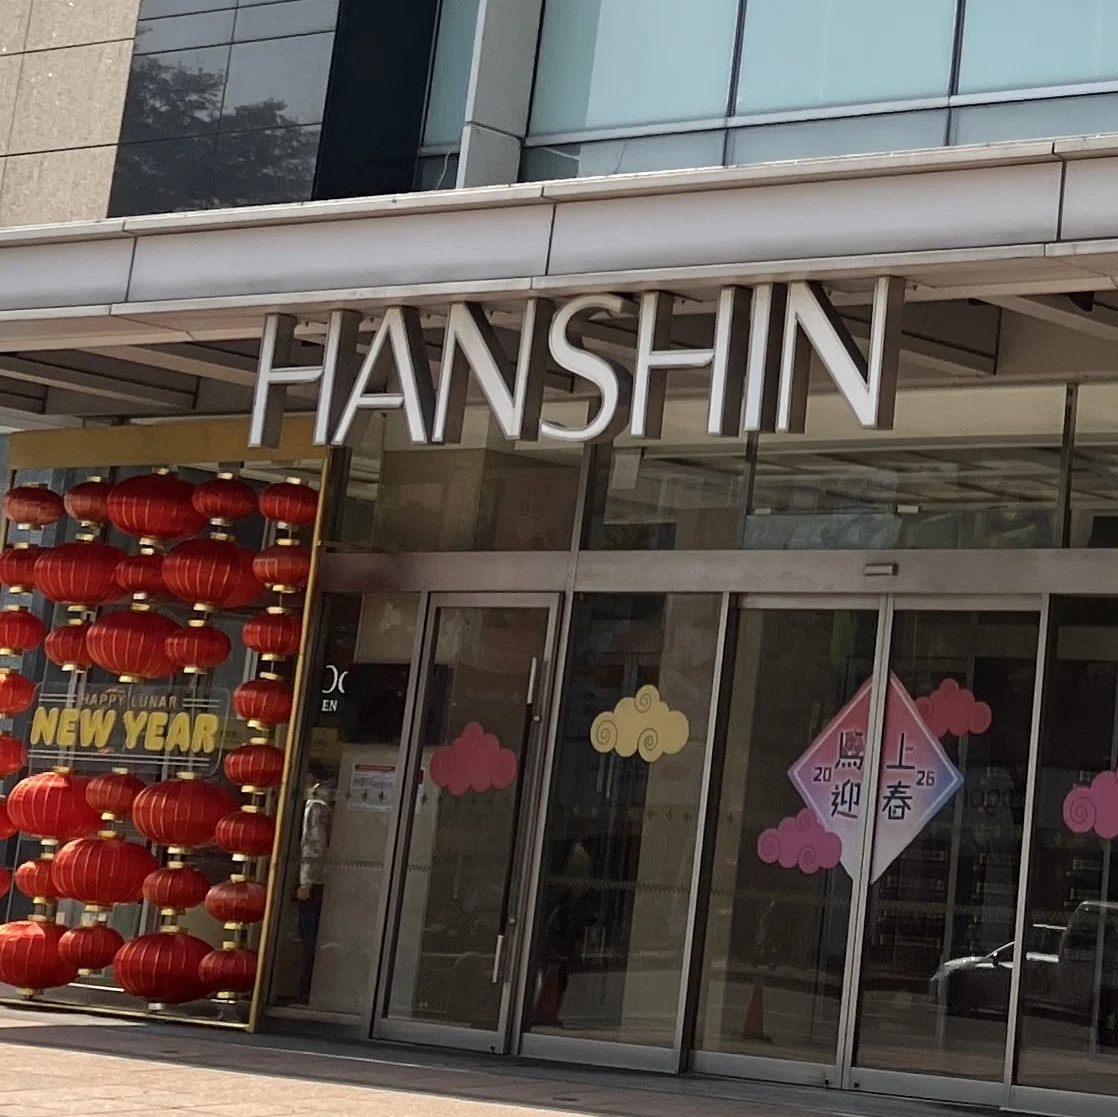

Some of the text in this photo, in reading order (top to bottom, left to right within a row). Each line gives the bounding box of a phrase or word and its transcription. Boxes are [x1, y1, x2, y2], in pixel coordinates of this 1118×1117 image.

[248, 276, 904, 449] HANSHIN
[82, 693, 178, 709] HAPPY LUNAR
[30, 706, 220, 753] NEW YEAR
[812, 766, 936, 787] 20 26
